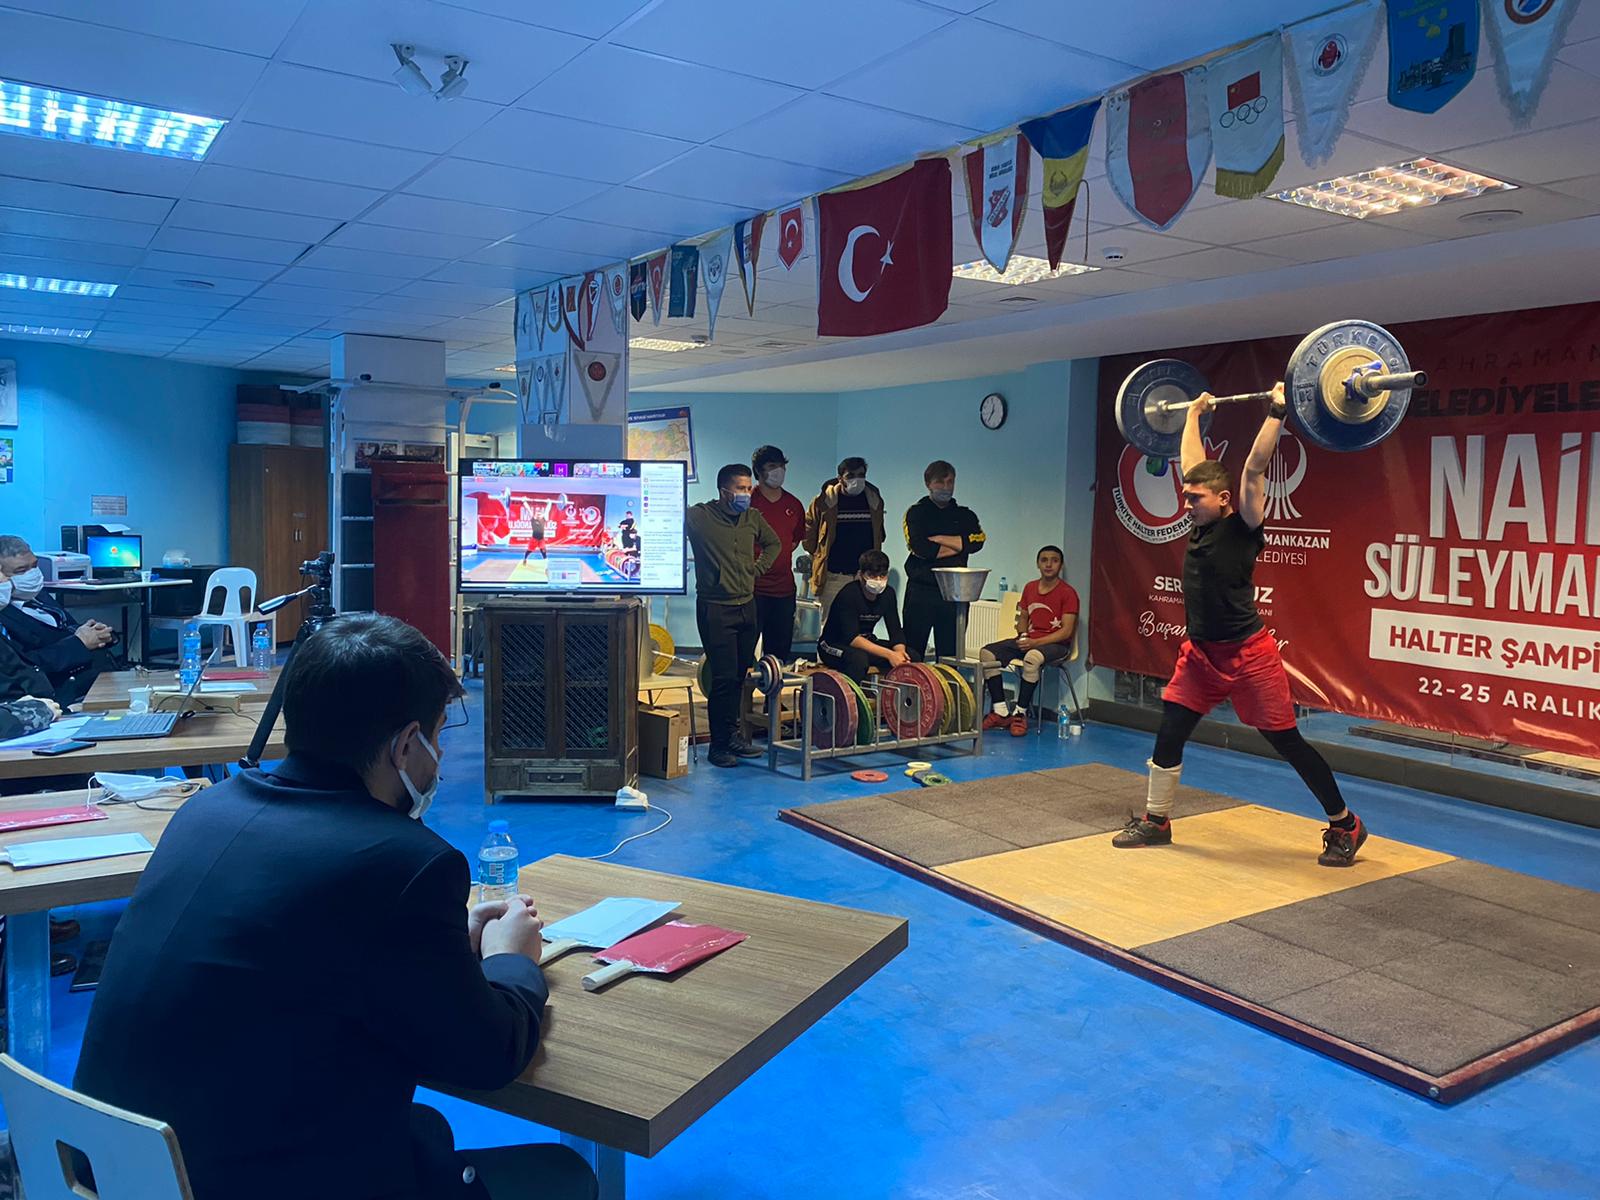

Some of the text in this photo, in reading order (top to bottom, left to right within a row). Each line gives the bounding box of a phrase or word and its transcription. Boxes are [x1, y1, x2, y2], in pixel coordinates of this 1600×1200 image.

[1436, 343, 1600, 372] AHRAMAN
[1409, 376, 1600, 417] ELEDİYELE
[1429, 431, 1600, 545] NAİ
[1132, 521, 1156, 537] HALTER
[1156, 513, 1193, 537] FEDERAS
[1263, 533, 1330, 549] MANKAZAN
[1256, 549, 1307, 566] LEDİYESİ
[1153, 575, 1184, 593] SER
[1363, 533, 1600, 619] SÜLEYMA
[1149, 594, 1184, 604] KAHRAMA
[1389, 625, 1492, 660] HALTER
[1418, 676, 1600, 721] 22-25 ARALIK
